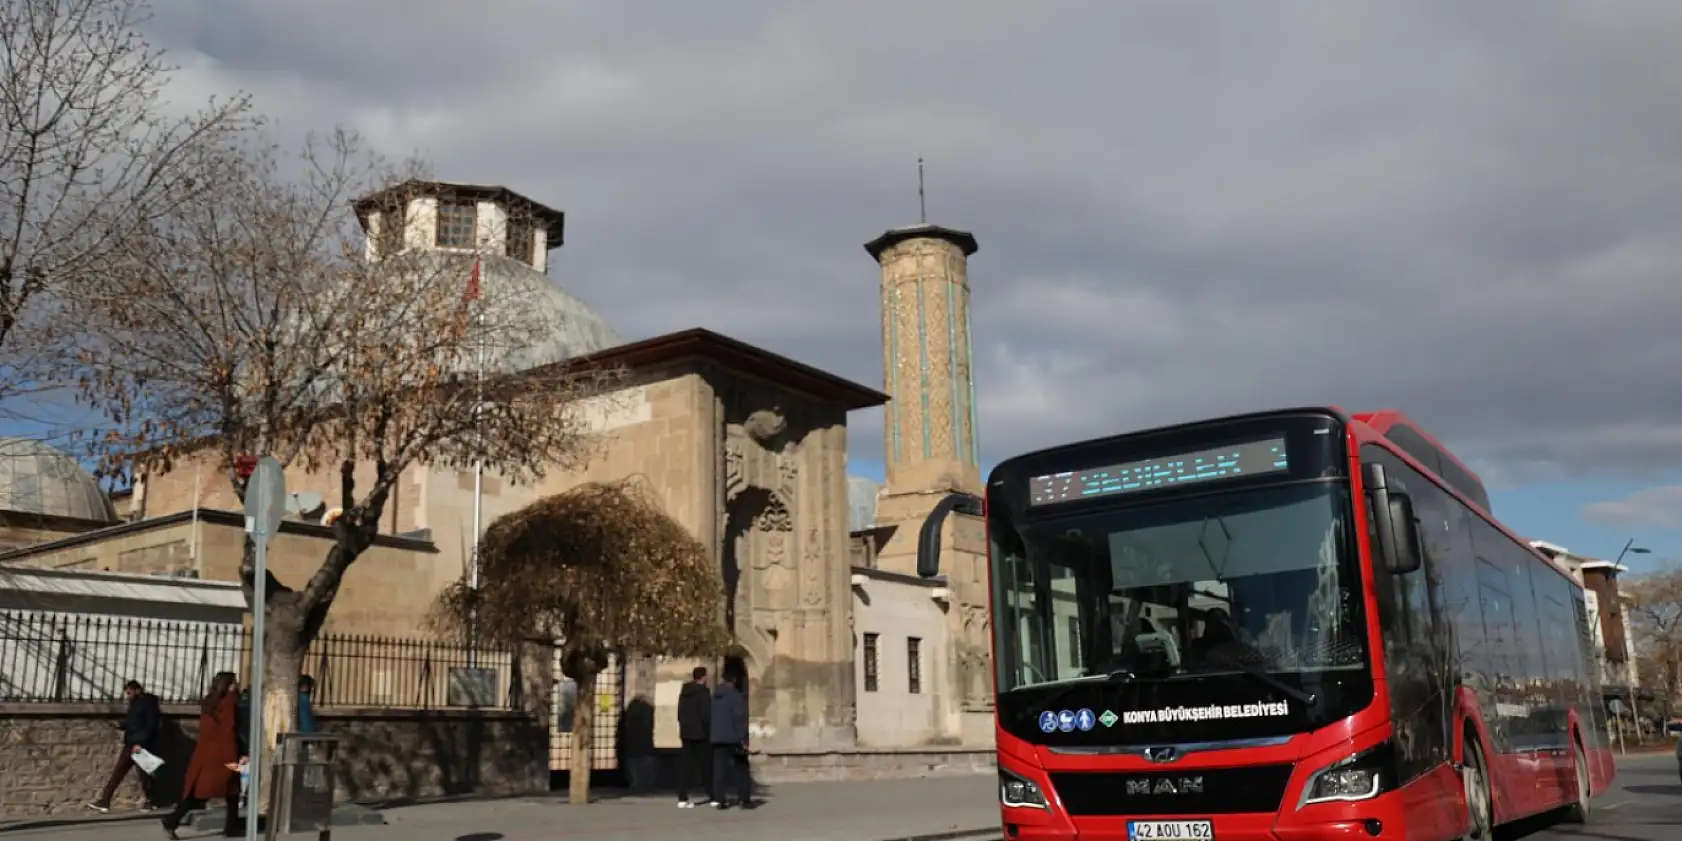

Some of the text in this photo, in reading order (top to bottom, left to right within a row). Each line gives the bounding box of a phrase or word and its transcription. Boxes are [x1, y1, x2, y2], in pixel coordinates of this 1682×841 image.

[1036, 471, 1074, 501] 37
[1123, 699, 1289, 724] KONYA BÜYÜKŞEHİR BELEDİYESİ
[1125, 776, 1203, 794] MAN
[1136, 823, 1152, 838] 42
[1186, 823, 1210, 838] 162
